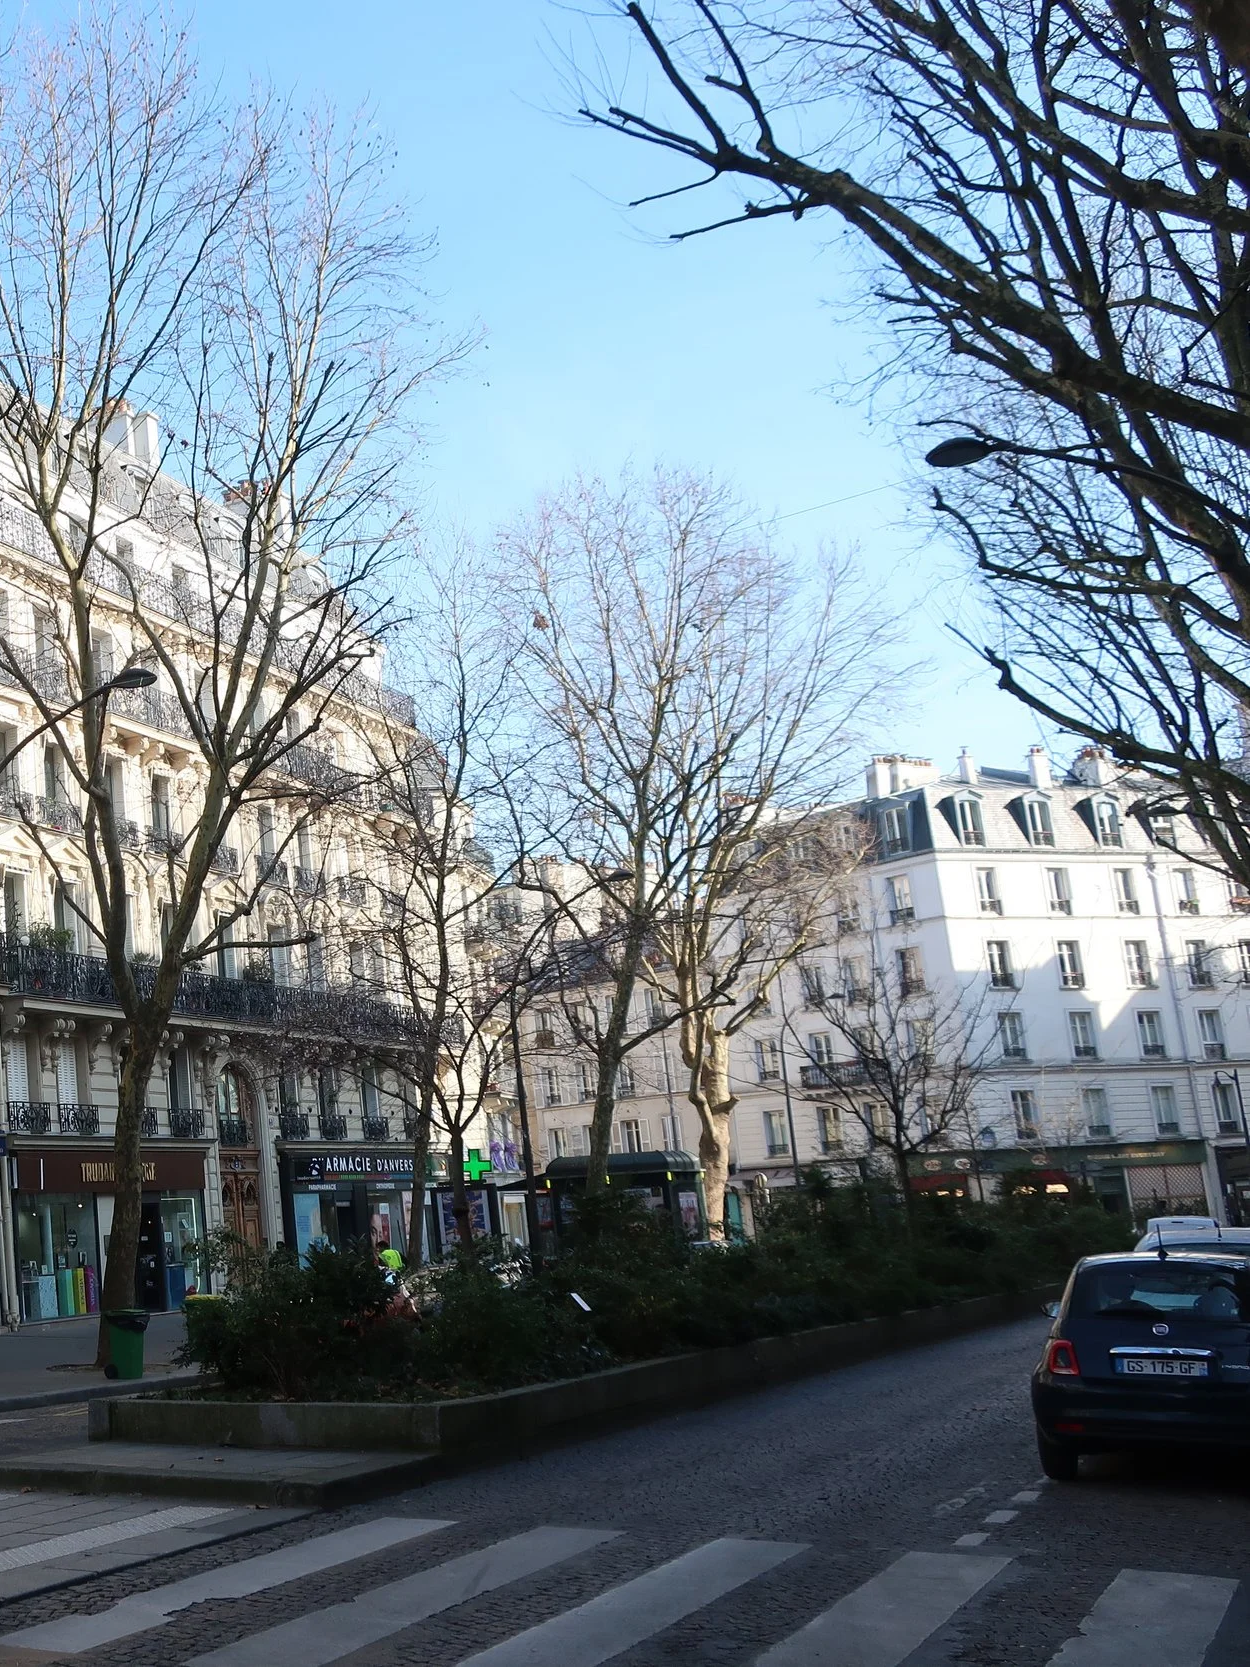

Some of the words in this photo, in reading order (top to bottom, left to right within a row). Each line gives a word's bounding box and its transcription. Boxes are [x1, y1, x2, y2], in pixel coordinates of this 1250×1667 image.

[312, 1157, 372, 1172] ARMACIE
[376, 1158, 414, 1172] D'ANVERS
[1127, 1360, 1196, 1374] GS-175-GF
